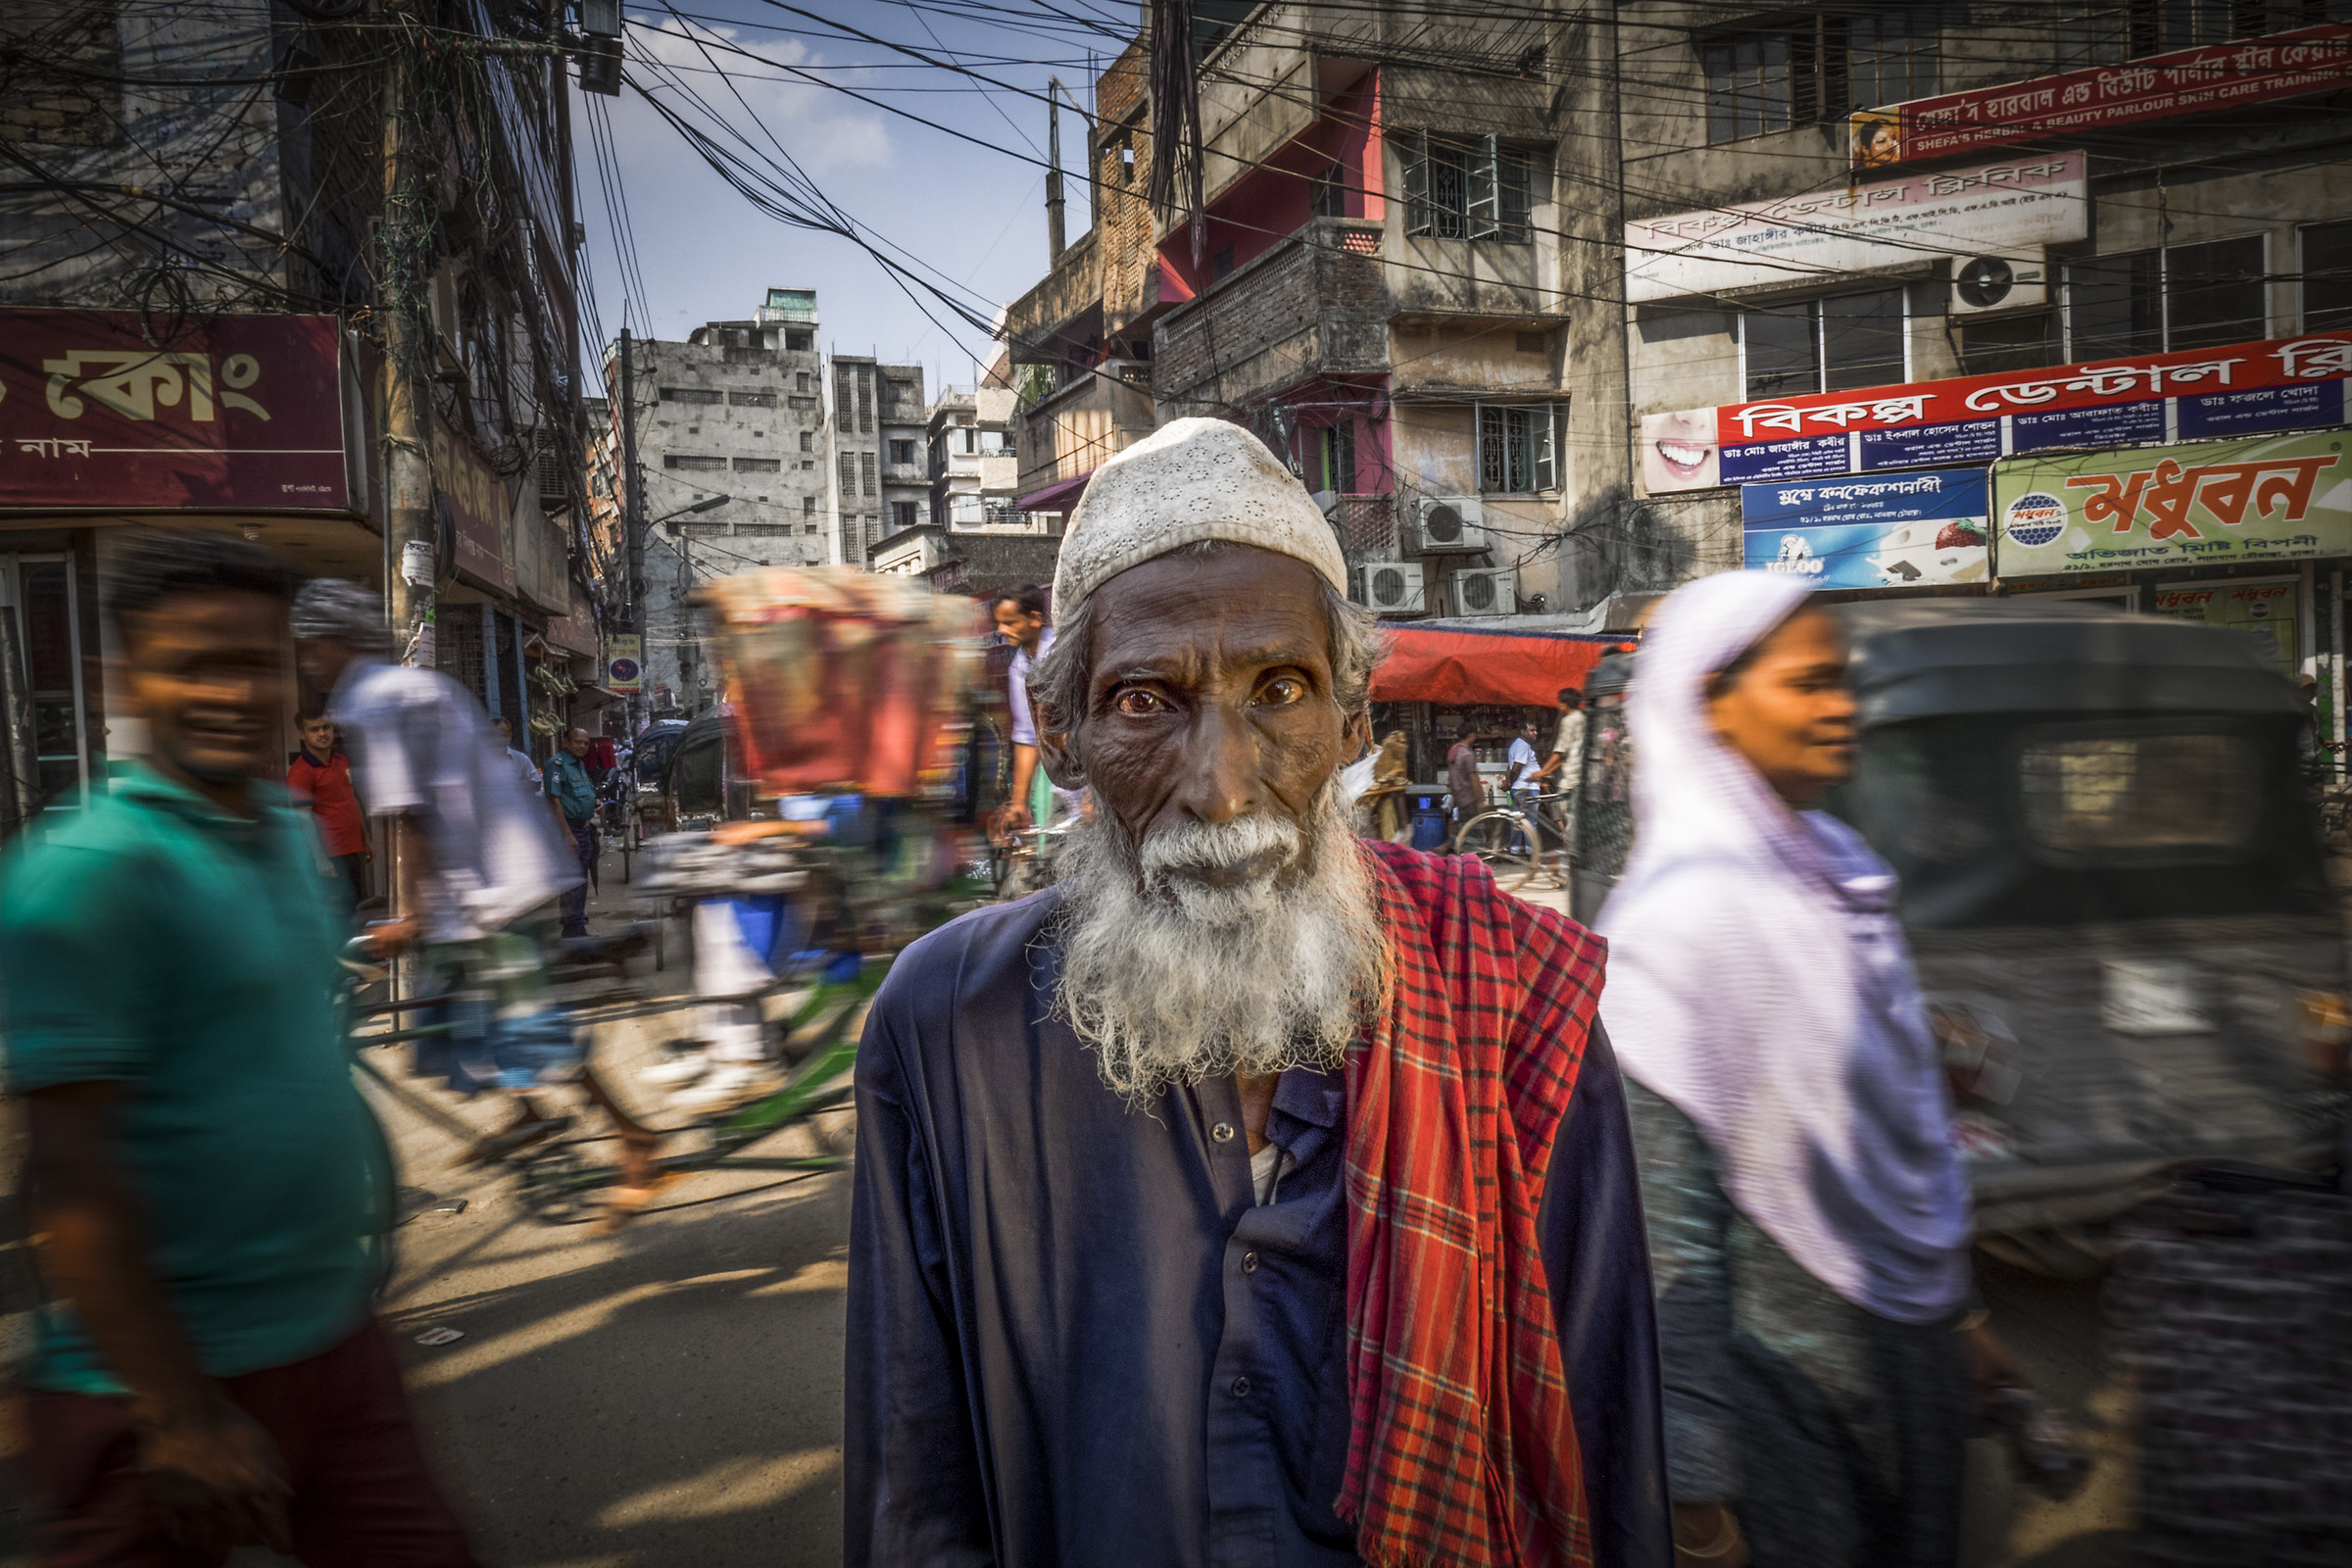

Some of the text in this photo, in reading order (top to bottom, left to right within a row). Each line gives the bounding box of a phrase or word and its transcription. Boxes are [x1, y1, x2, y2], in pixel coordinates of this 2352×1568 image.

[1984, 88, 2056, 119] হারবাল
[2061, 80, 2093, 105] এন্ড
[2097, 65, 2158, 99] বিউটি
[1917, 132, 1970, 152] SHEFA'S
[1974, 123, 2027, 142] HERBAL
[2046, 110, 2103, 128] BEAUTY
[2107, 98, 2175, 119] PARLOUR
[2179, 90, 2215, 105] SKIN
[2219, 83, 2260, 98] CARE
[1642, 161, 2068, 239] বিকল্প ডেন্টাল ক্লিনিক
[1736, 227, 1788, 246] জাহাঙ্গীর
[42, 349, 271, 421] কোং
[2201, 395, 2225, 406] ডাঃ
[2280, 385, 2320, 399] খোদা
[1730, 394, 1938, 438] বিকল্প
[1964, 357, 2248, 412] ডেন্টাল
[1864, 432, 1883, 442] ডাঃ
[1885, 428, 1921, 440] ইকবাল
[1924, 424, 1960, 437] হোসেন
[1963, 420, 1996, 431] শোভন
[2017, 416, 2037, 425] ডাঃ
[2041, 414, 2067, 423] মোঃ
[16, 438, 93, 459] নাম
[1724, 436, 1845, 459] ডাঃ মোঃ জাহাঙ্গীর কবীর
[1819, 475, 1942, 501] কনফেকশনারী
[2064, 454, 2342, 540] মধুবন
[2067, 534, 2320, 563] অভিজাত মিষ্টি বিপনী
[1766, 559, 1824, 573] IGLOO
[2227, 586, 2291, 602] মধুবন
